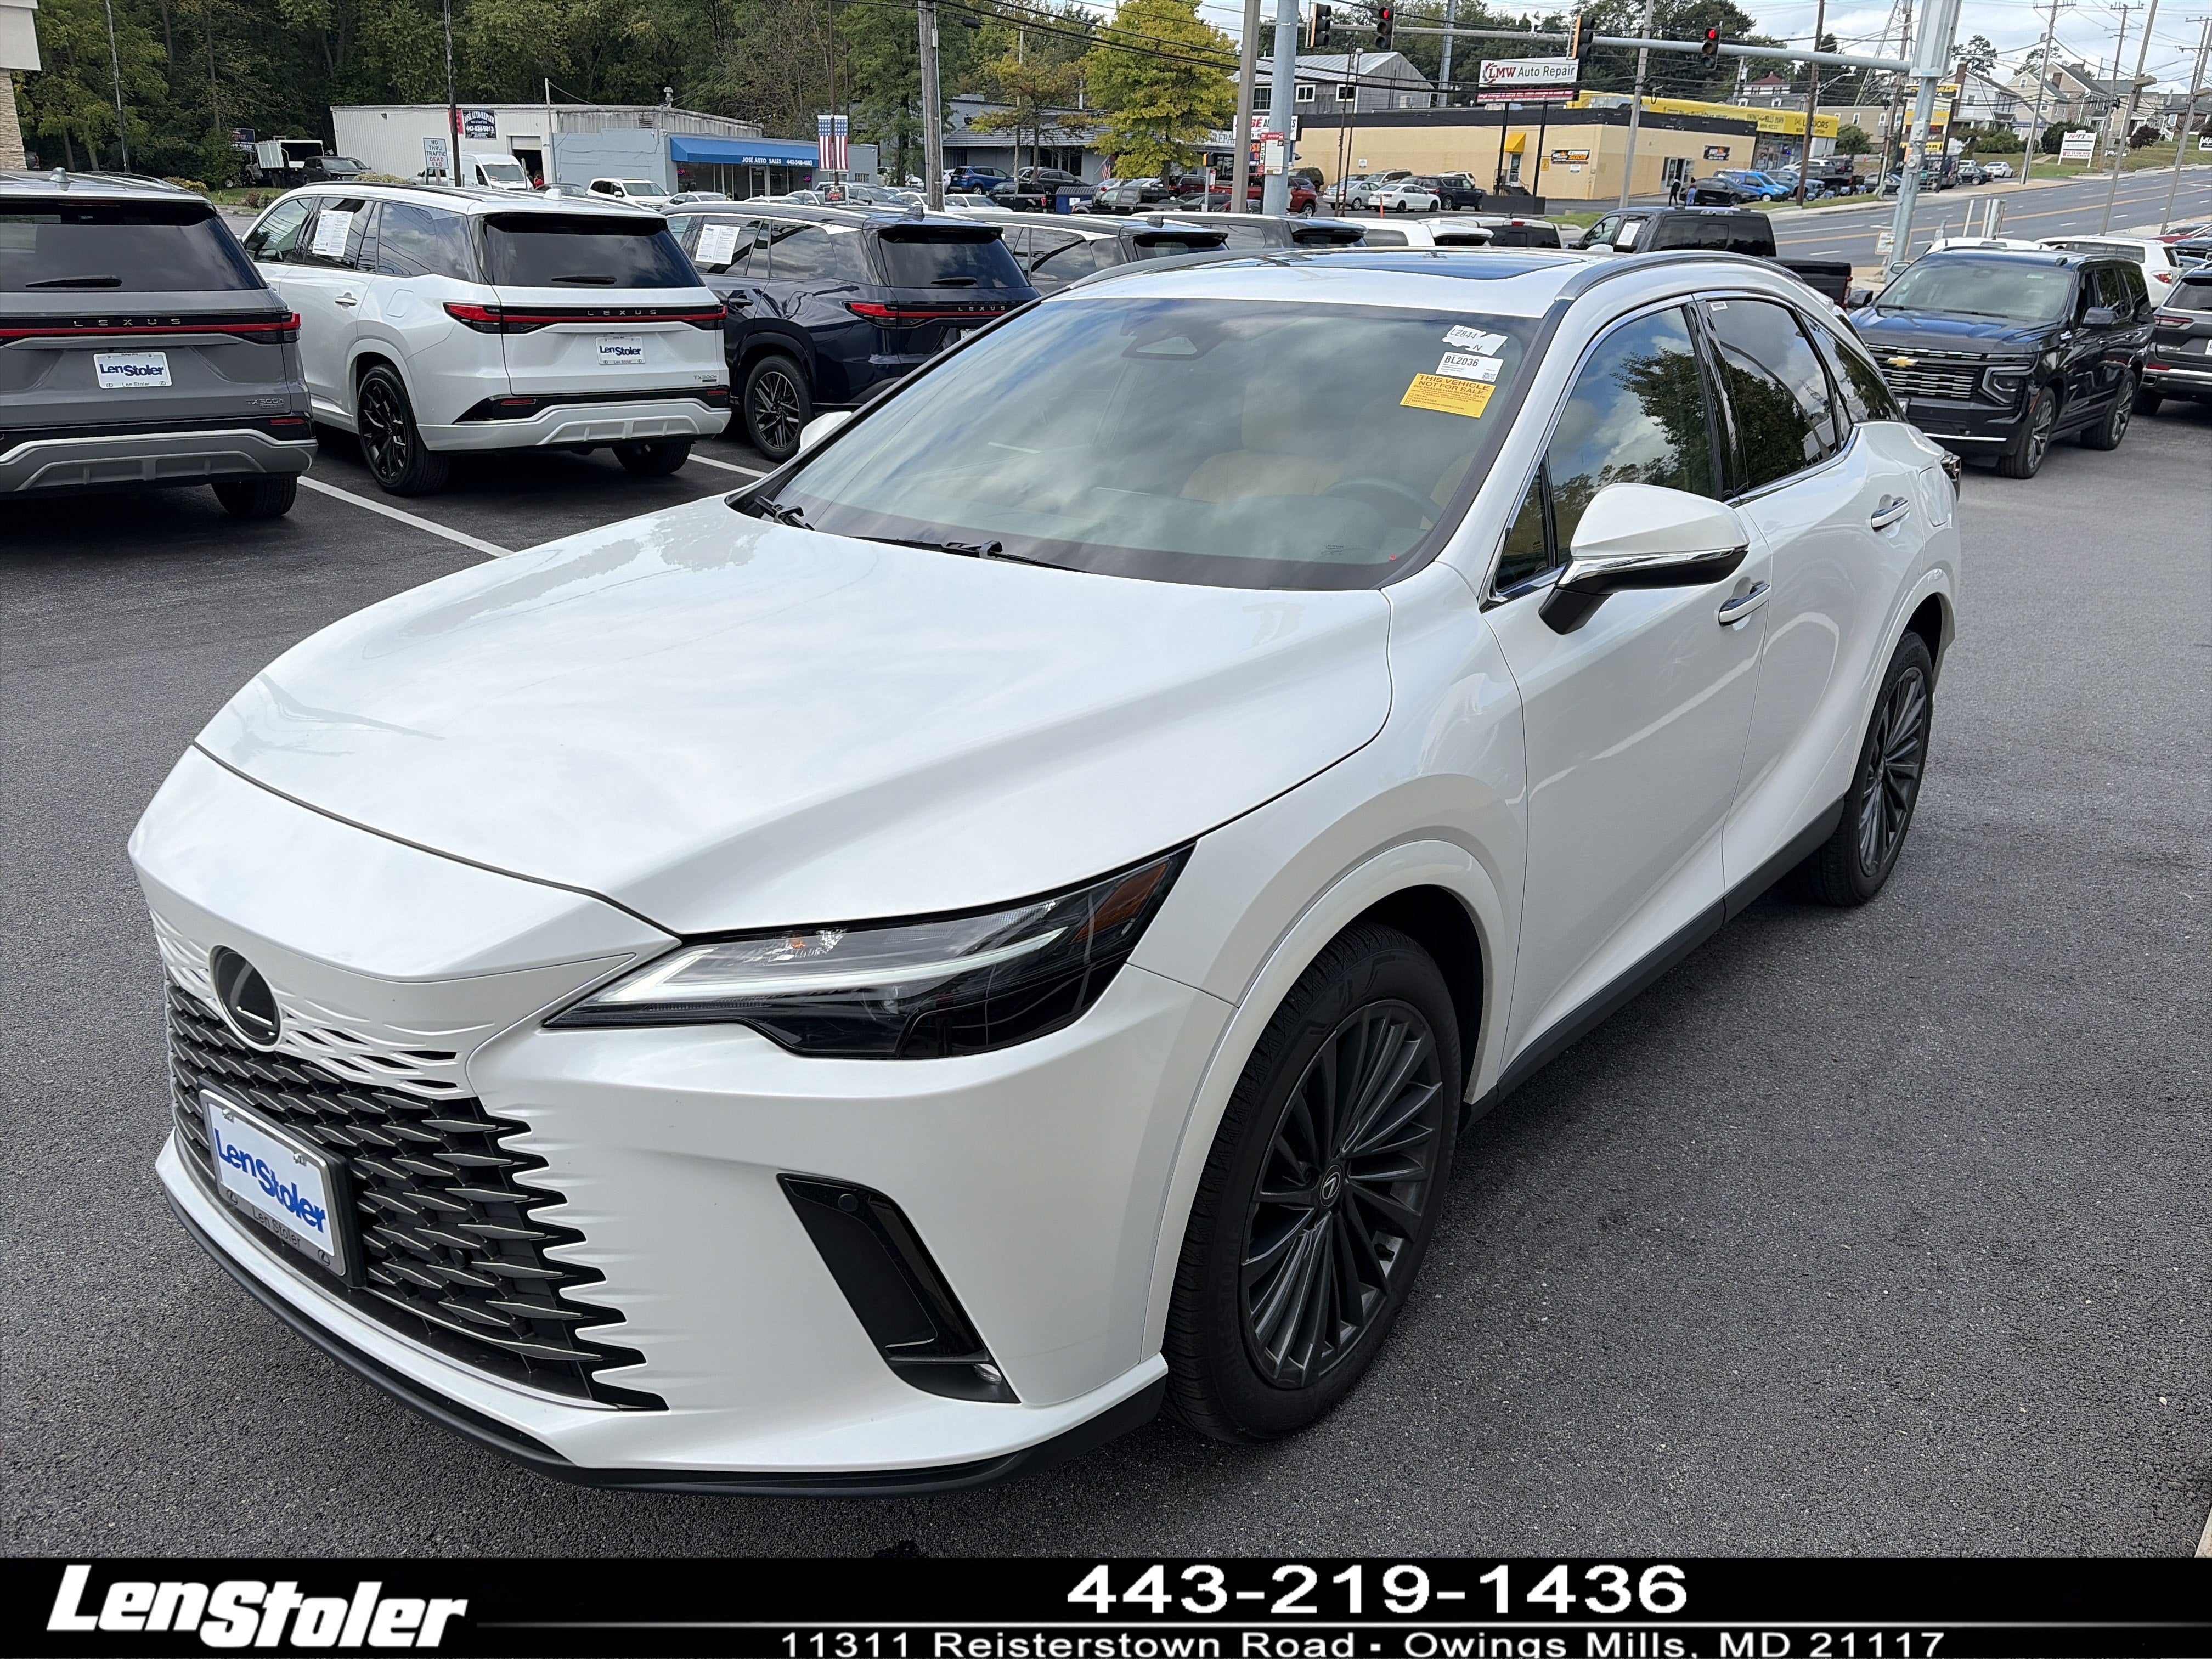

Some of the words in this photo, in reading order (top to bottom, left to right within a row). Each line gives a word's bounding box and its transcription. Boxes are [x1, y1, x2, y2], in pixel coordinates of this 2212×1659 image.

[1489, 67, 1516, 78] LMW
[1517, 67, 1540, 77] Auto
[1543, 65, 1575, 78] Repair
[73, 318, 181, 328] LEXUS
[600, 346, 641, 356] LenStoler
[1444, 356, 1480, 367] BL2036
[99, 364, 165, 376] LenStoler
[1443, 379, 1490, 390] VEHICLE
[215, 1128, 326, 1233] LenStoler
[252, 1206, 272, 1228] Len
[273, 1215, 301, 1247] Stoler
